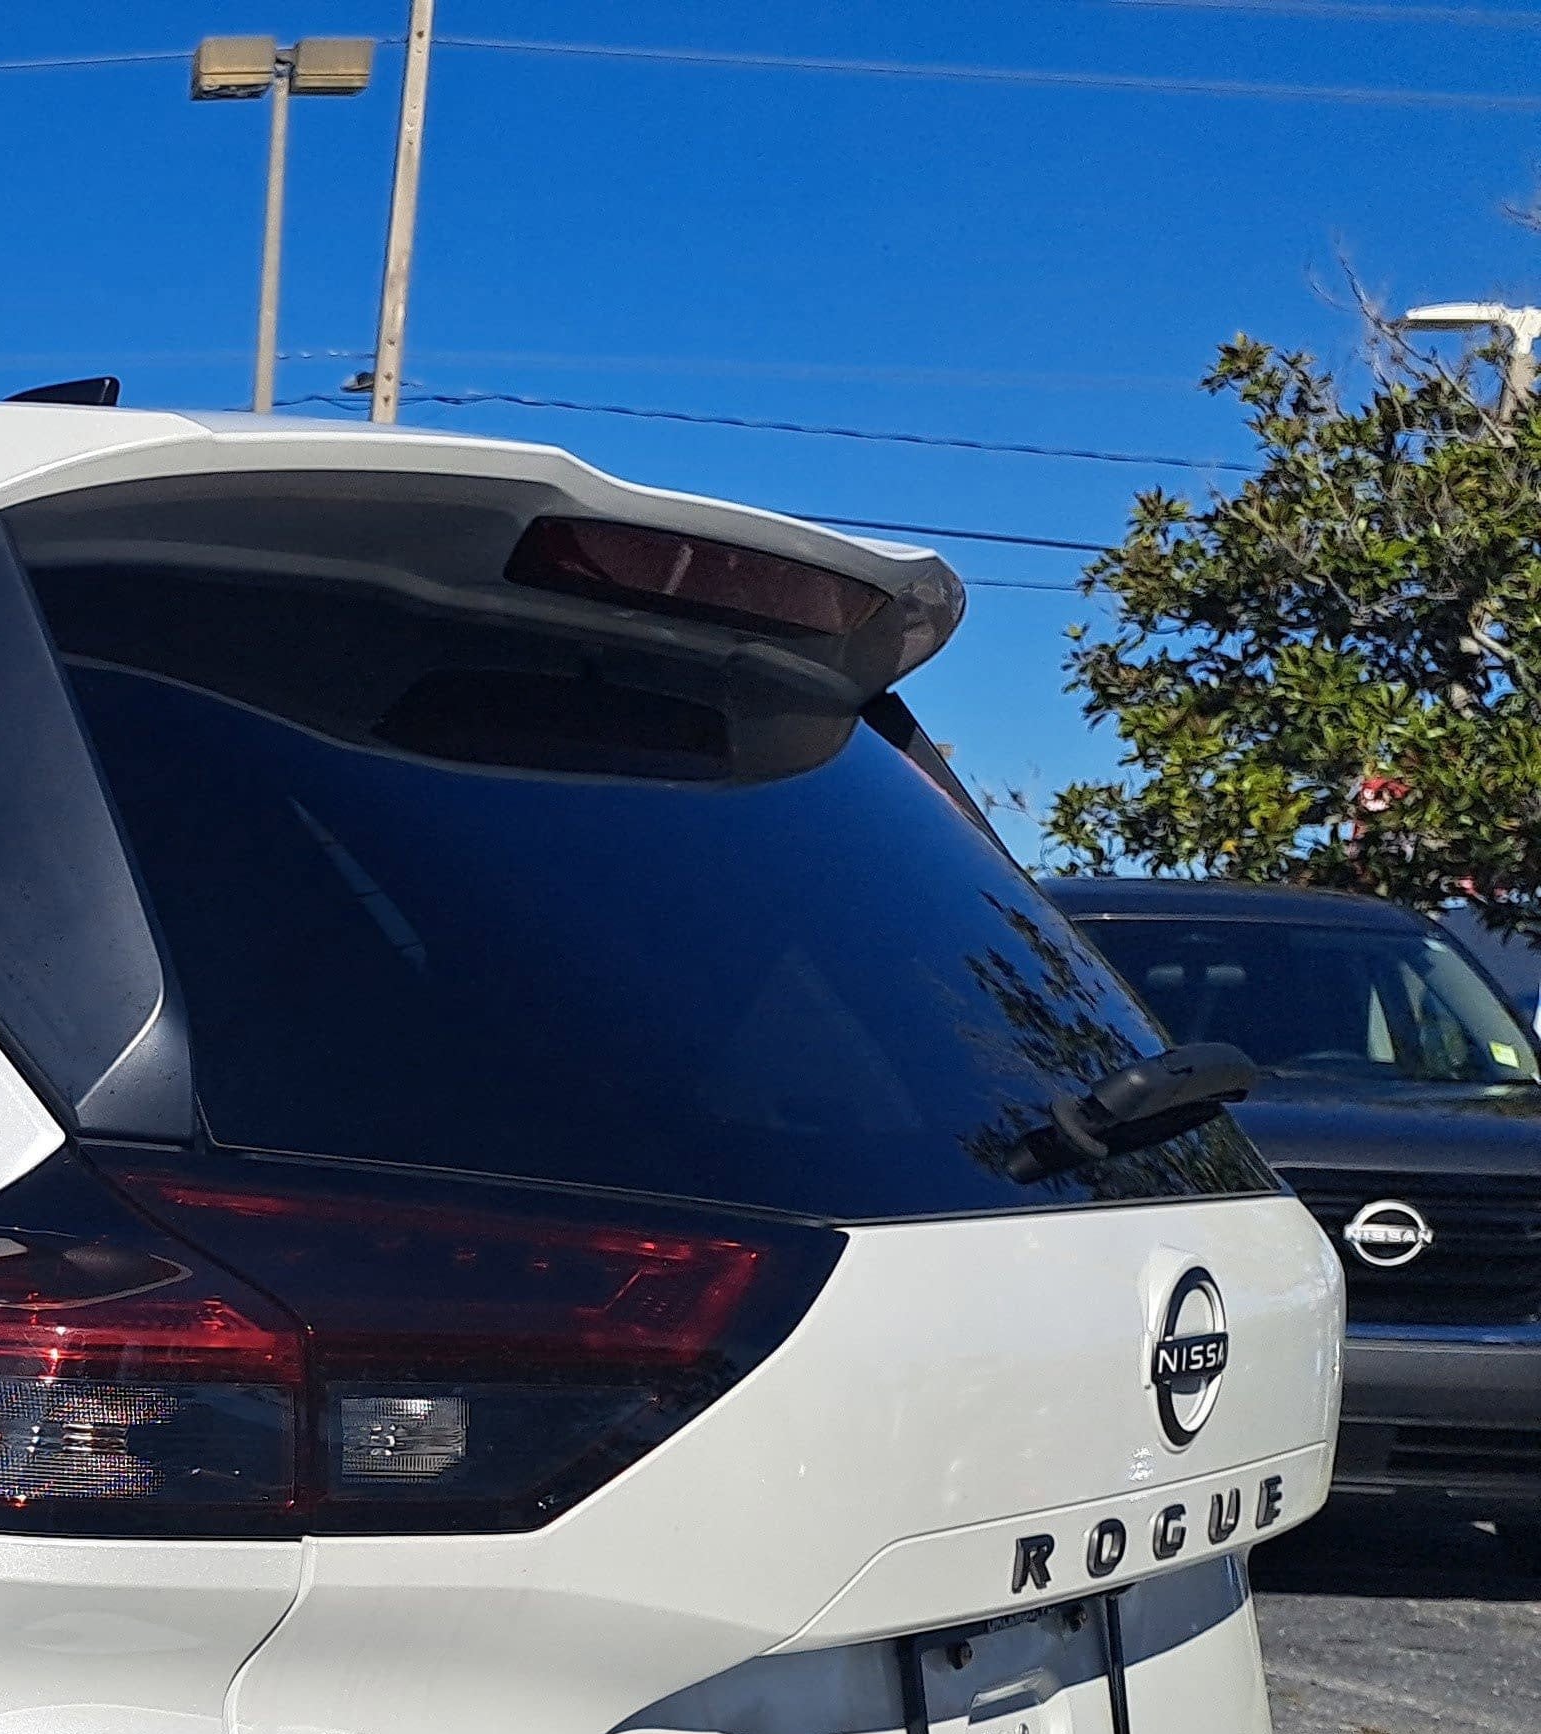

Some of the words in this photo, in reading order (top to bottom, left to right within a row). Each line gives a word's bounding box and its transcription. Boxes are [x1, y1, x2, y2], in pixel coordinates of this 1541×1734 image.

[1344, 1224, 1434, 1244] NISSAN
[1158, 1340, 1224, 1374] NISSA
[1011, 1475, 1282, 1594] ROGUE
